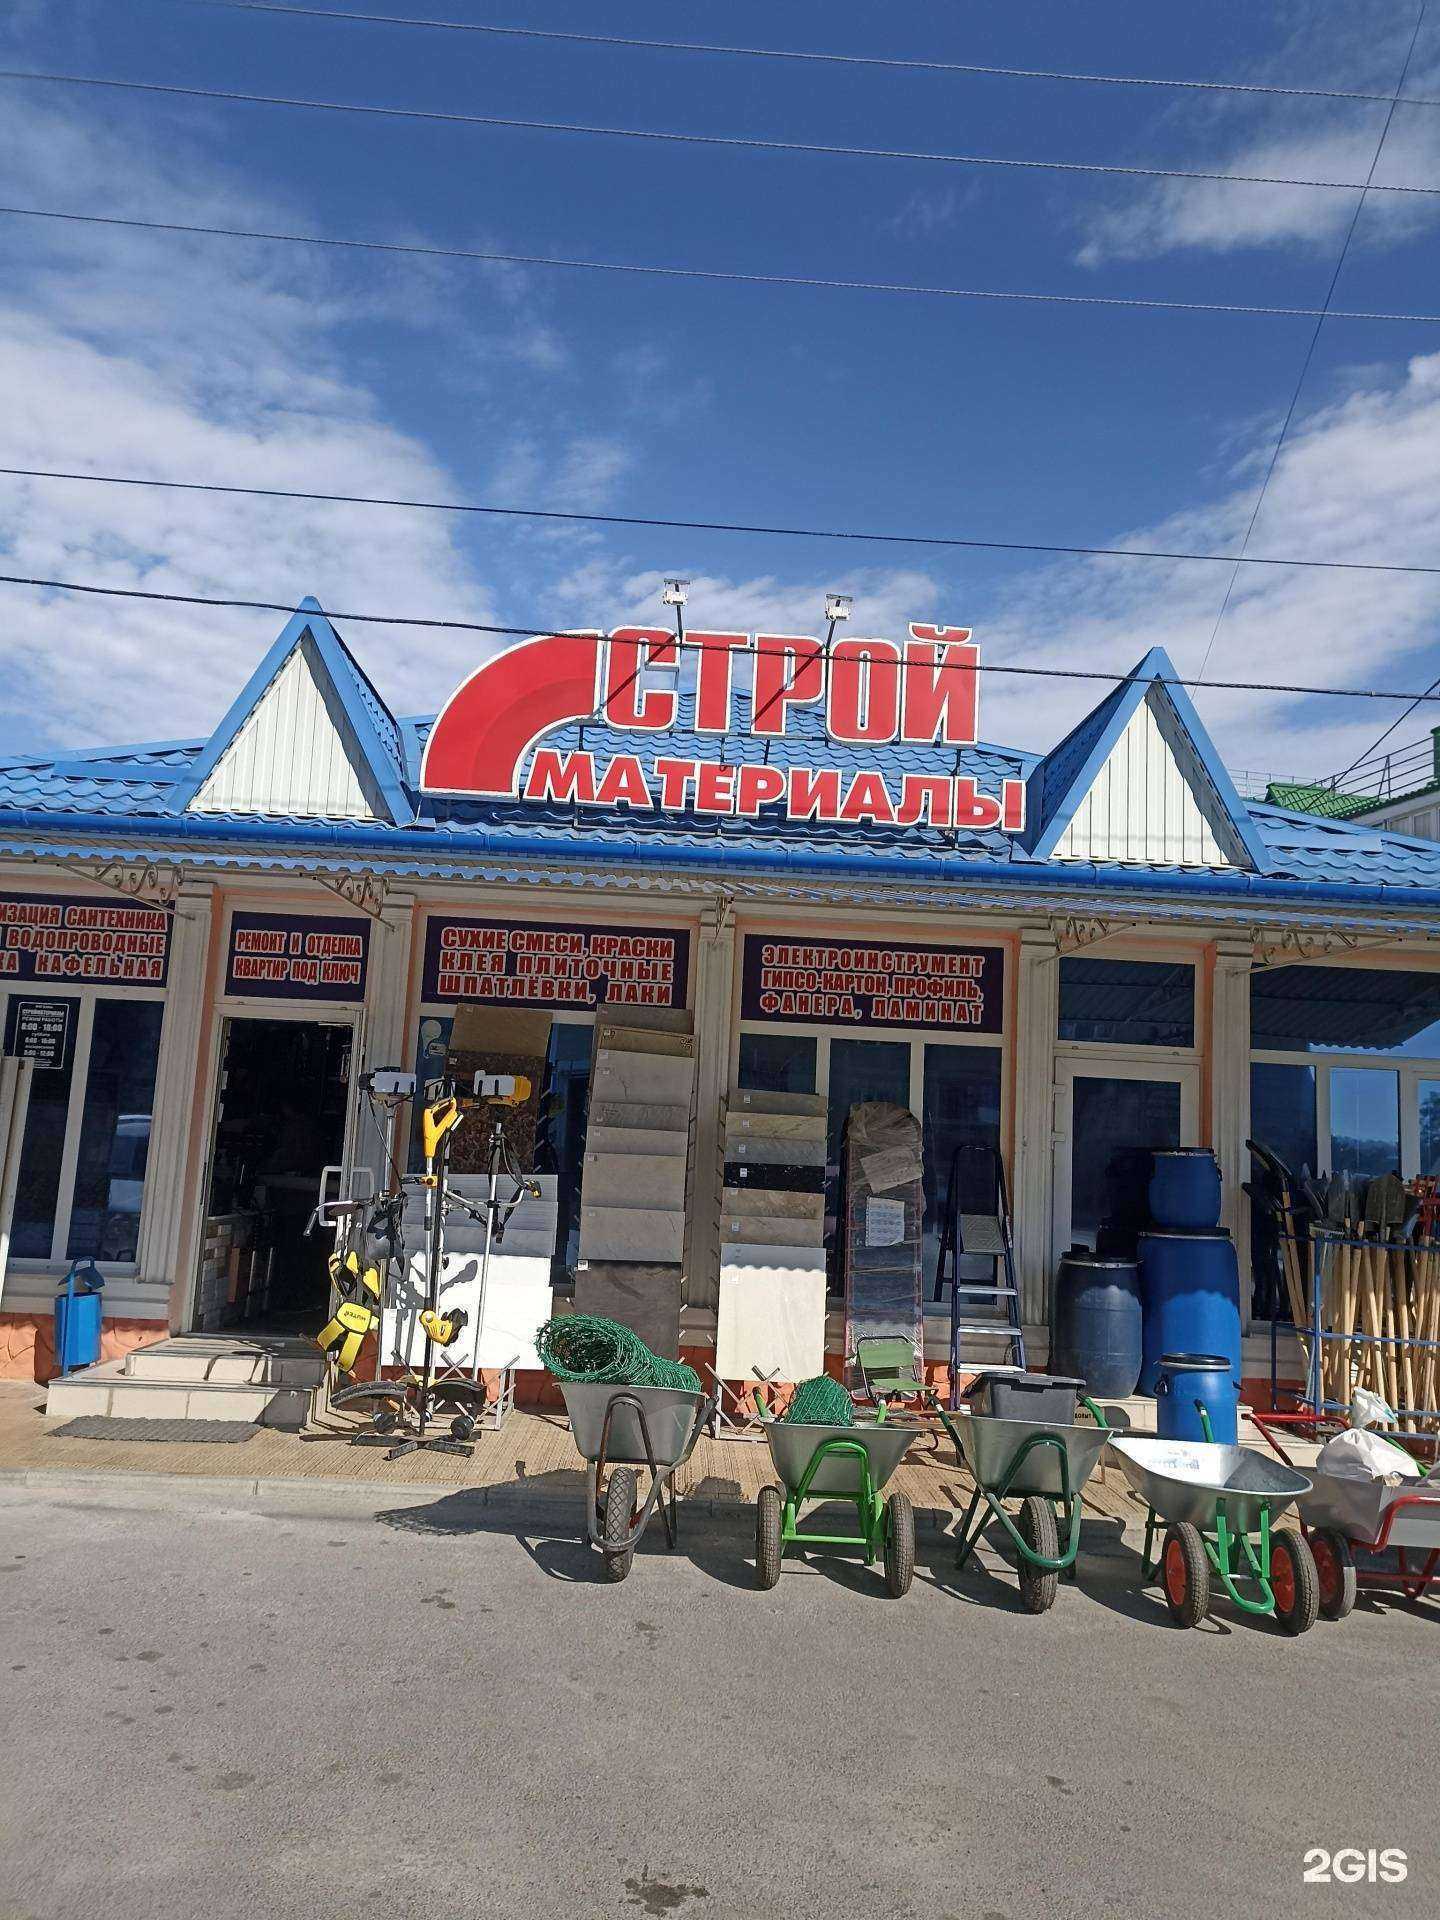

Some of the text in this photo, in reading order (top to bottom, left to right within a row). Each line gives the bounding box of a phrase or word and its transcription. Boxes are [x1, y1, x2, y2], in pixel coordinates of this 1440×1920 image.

[603, 622, 981, 746] СТРОЙ
[524, 748, 1027, 832] МАТЕРИАЛЫ
[65, 906, 168, 932] САНТЕХНИКА
[6, 927, 166, 956] ВОДОПРОВОДНЫЕ
[235, 929, 362, 959] РЕМОНТ И ОТДЕЛКА
[440, 927, 675, 960] СУХИЕ СМЕСИ, КРАСКИ
[35, 952, 164, 980] КАФЕЛЬНАЯ
[233, 956, 361, 985] КВАРТИР ПОД КЛЮЧ
[439, 950, 674, 983] КЛЕЯ ПЛИТОЧНЫЕ
[761, 944, 985, 977] ЭЛЕКТРОИНСТРУМЕНТ
[437, 972, 673, 1006] ШПАТЛЁВКИ, ЛАКИ
[761, 968, 984, 1000] ГИПСО-КАРТОН, ПРОФИЛЬ,
[760, 991, 984, 1024] ФАНЕРА, ЛАМИНАТ
